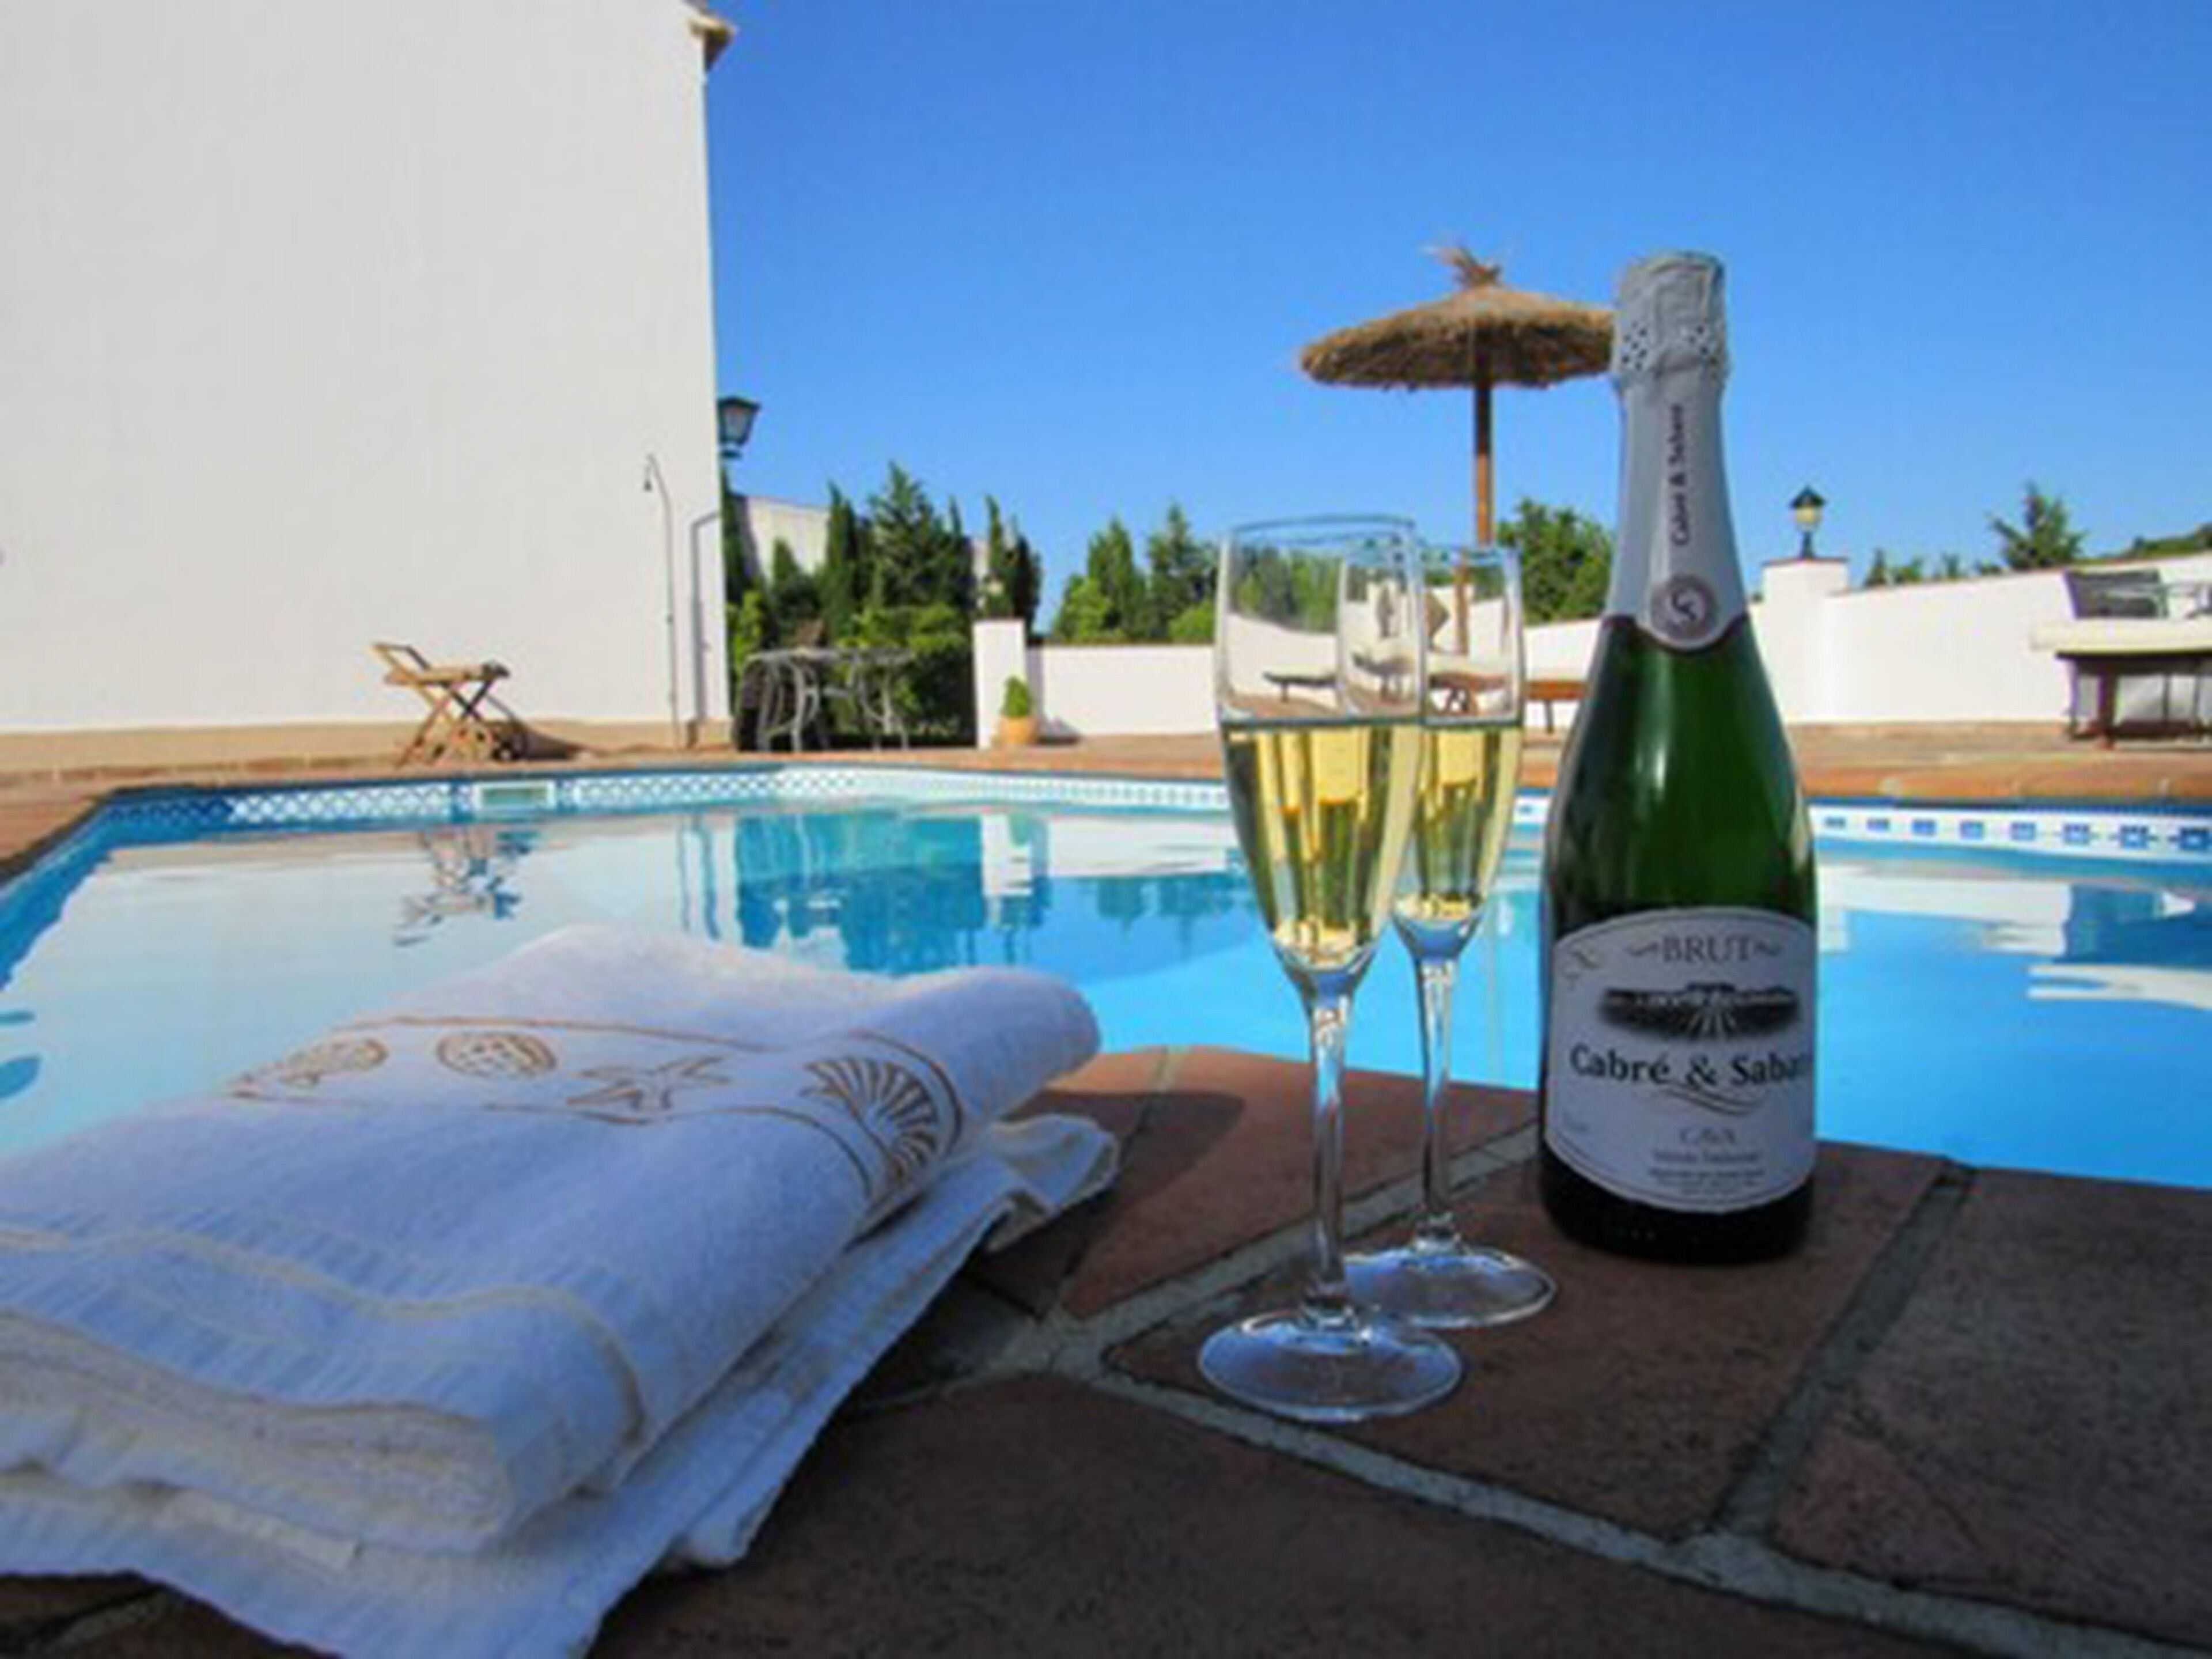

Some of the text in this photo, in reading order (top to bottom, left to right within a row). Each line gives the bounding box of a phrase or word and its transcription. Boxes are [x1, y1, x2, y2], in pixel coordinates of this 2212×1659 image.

[1662, 935, 1751, 963] BRUT
[1570, 1043, 1671, 1084] Cabré
[1685, 1055, 1718, 1088] &
